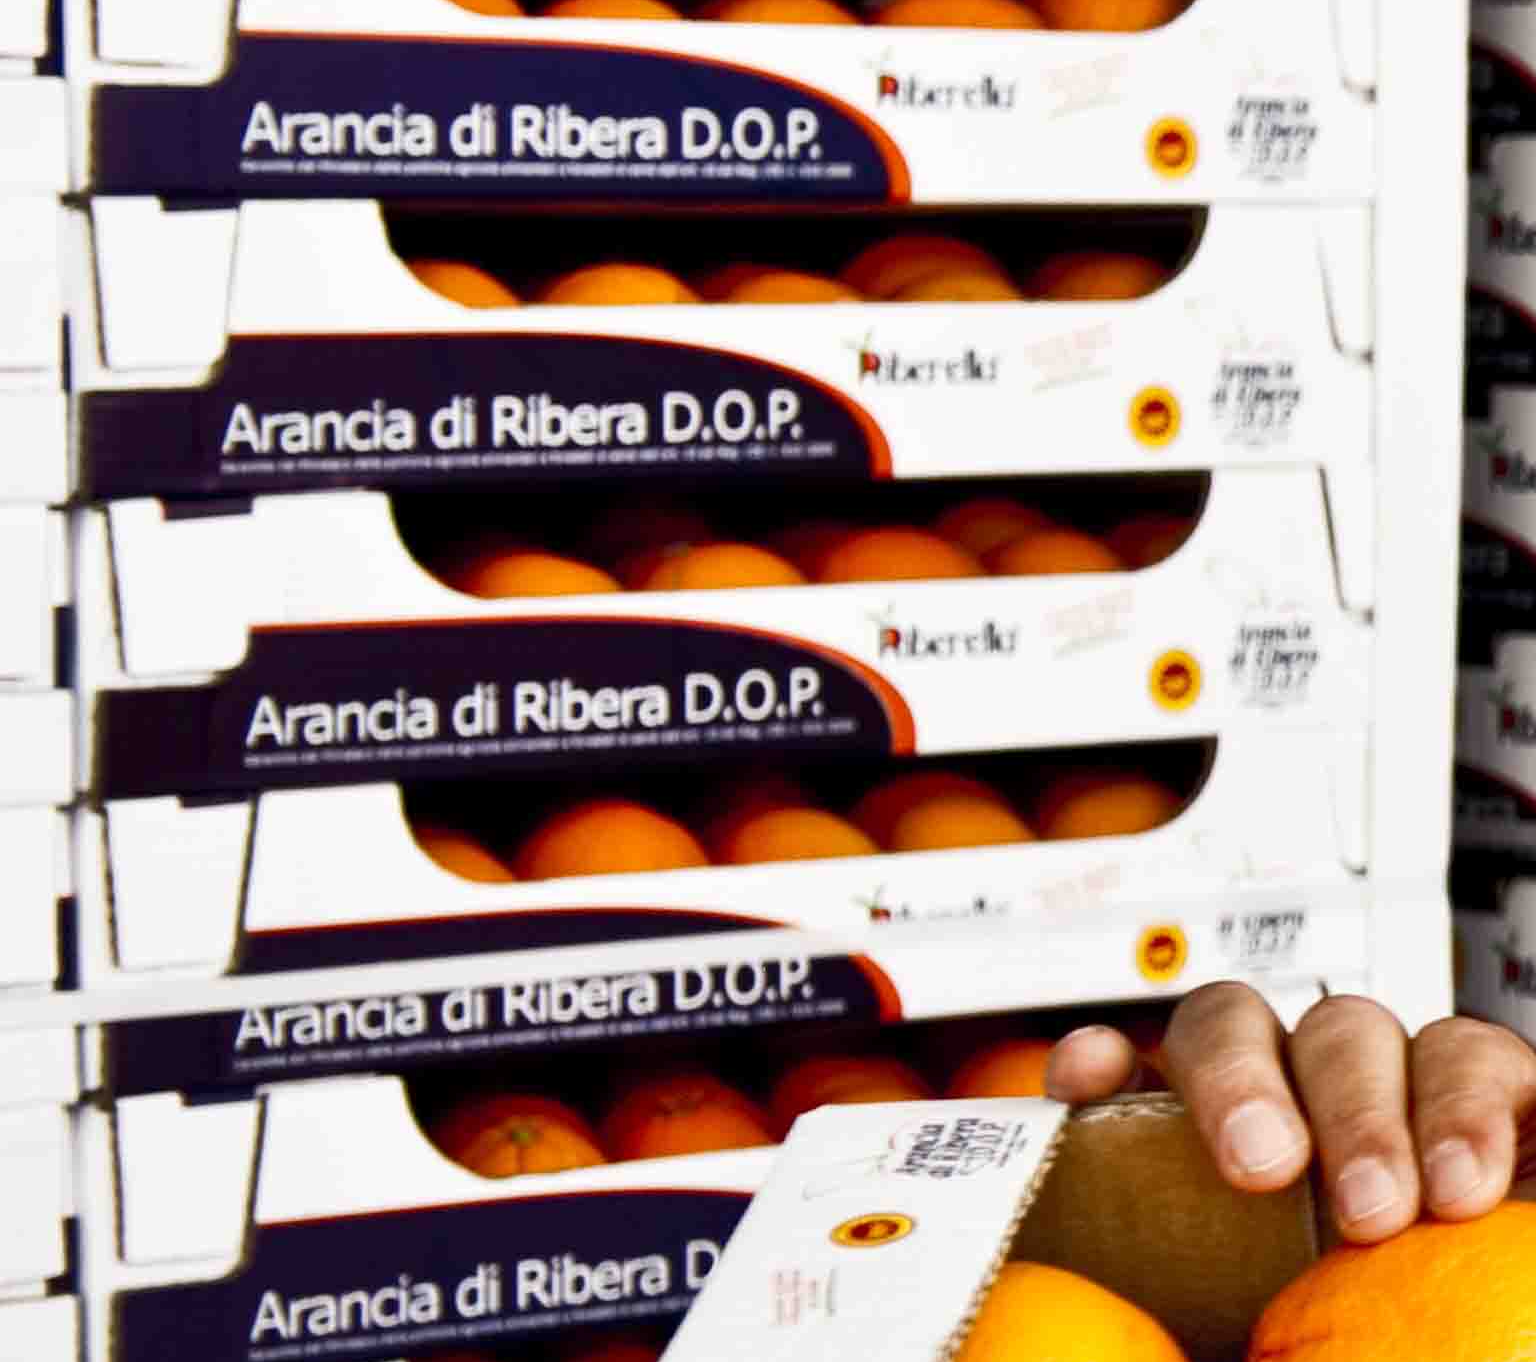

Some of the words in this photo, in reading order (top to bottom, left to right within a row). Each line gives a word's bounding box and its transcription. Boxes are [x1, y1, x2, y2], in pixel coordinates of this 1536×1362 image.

[242, 101, 436, 156] Arancia
[450, 103, 496, 158] di
[512, 104, 667, 160] Ribera
[682, 107, 820, 160] D.O.P.
[246, 689, 438, 746] Arancia
[453, 683, 498, 738] di
[515, 679, 669, 733] Ribera
[685, 666, 822, 724] D.O.P.
[235, 992, 428, 1049] Arancia
[442, 983, 487, 1032] di
[502, 969, 657, 1026] Ribera
[672, 955, 813, 1011] D.O.P.
[251, 1274, 440, 1342] Arancia
[456, 1264, 500, 1318] di
[517, 1254, 669, 1310] Ribera
